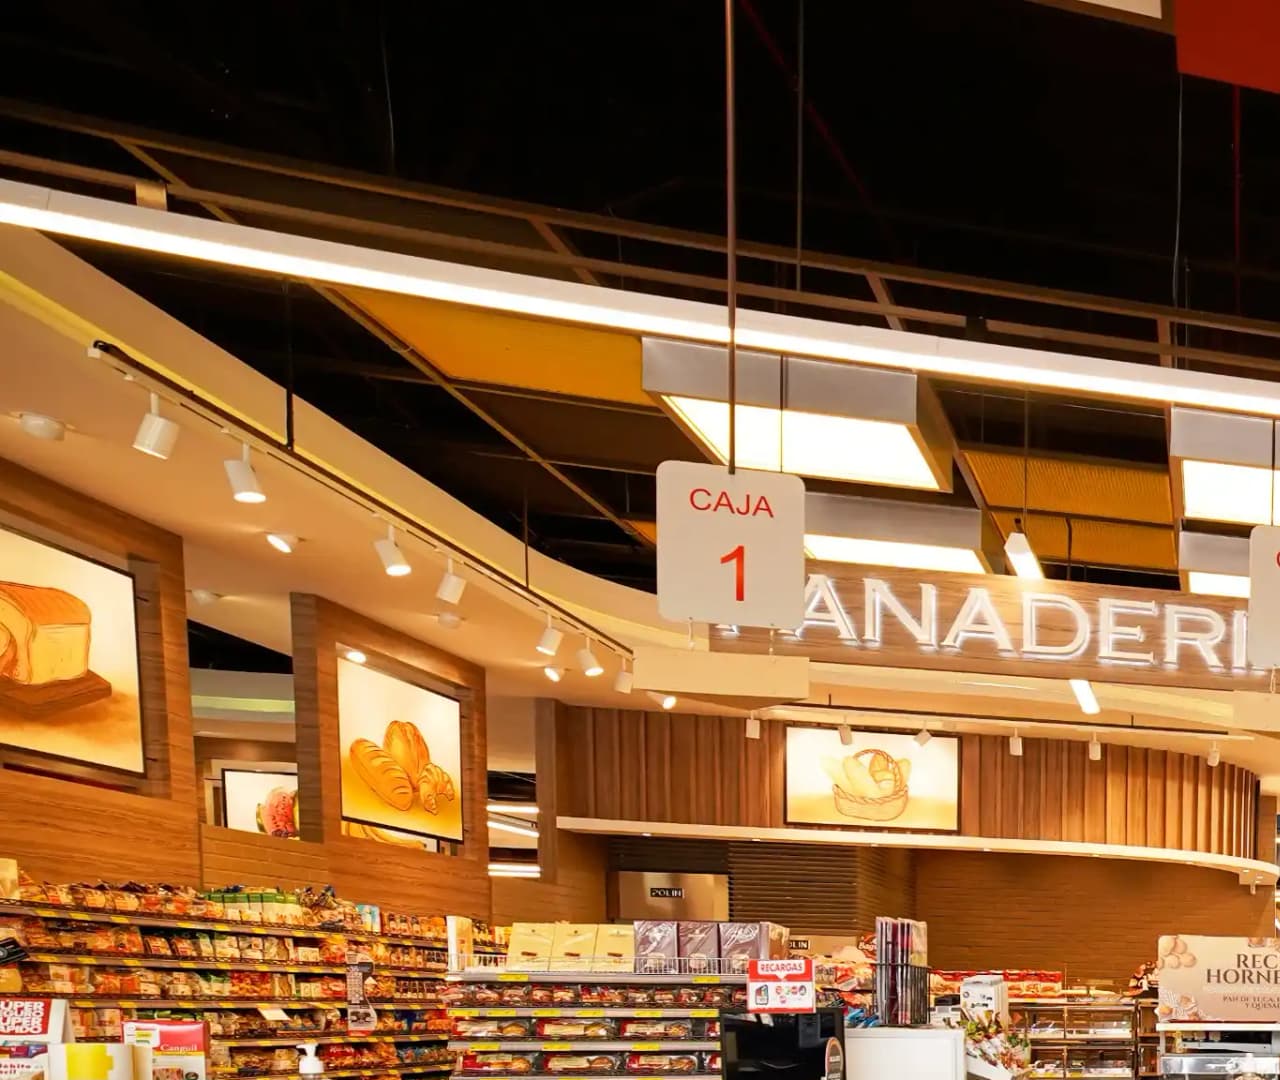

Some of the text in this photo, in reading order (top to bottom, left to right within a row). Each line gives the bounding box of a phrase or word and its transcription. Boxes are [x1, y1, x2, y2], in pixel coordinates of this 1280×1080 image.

[690, 488, 774, 518] CAJA
[720, 545, 744, 602] 1
[758, 572, 1262, 680] ANADERI
[760, 962, 803, 973] RECARGAS
[0, 1000, 45, 1010] UPER
[0, 1017, 43, 1026] UPER
